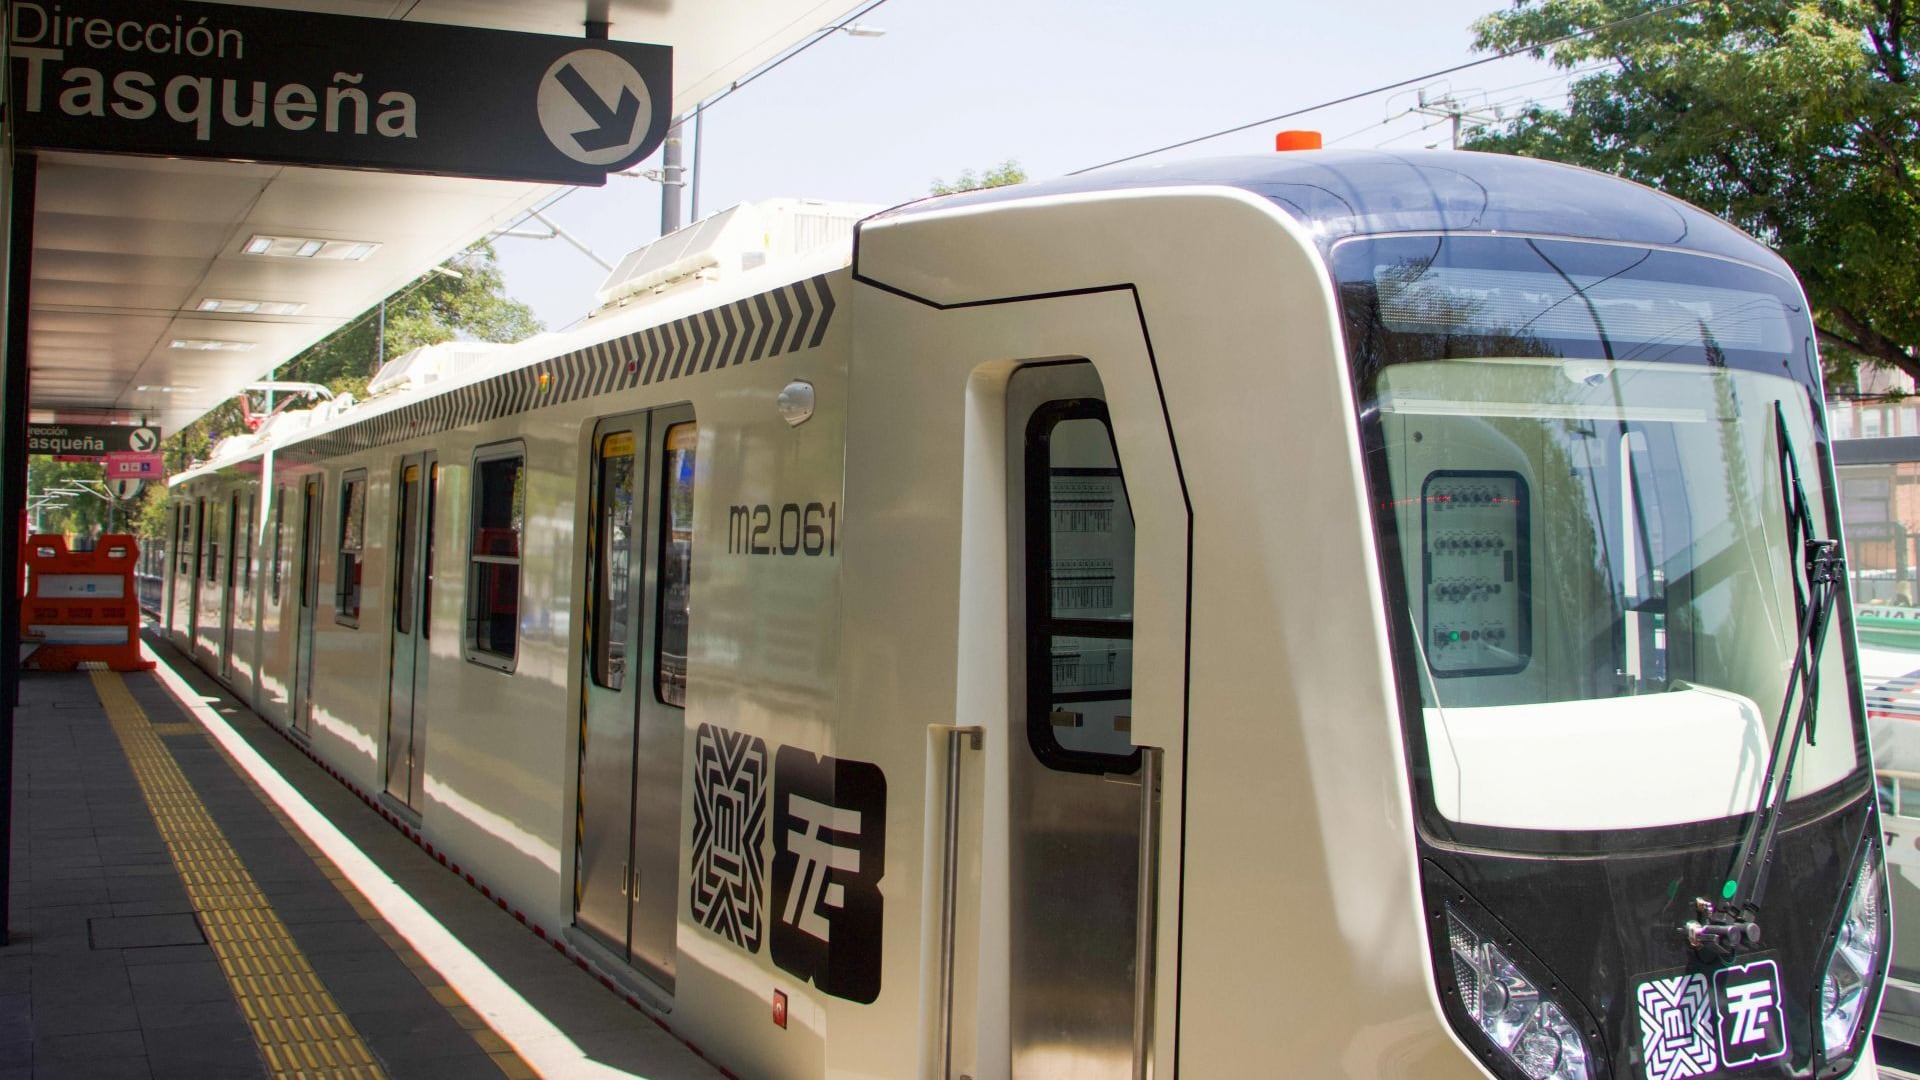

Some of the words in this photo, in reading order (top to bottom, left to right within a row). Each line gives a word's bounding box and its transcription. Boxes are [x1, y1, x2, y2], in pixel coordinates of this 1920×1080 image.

[10, 2, 244, 60] Dirección
[9, 45, 419, 141] Tasqueña
[29, 436, 105, 453] asqueña
[728, 501, 836, 557] m2.061
